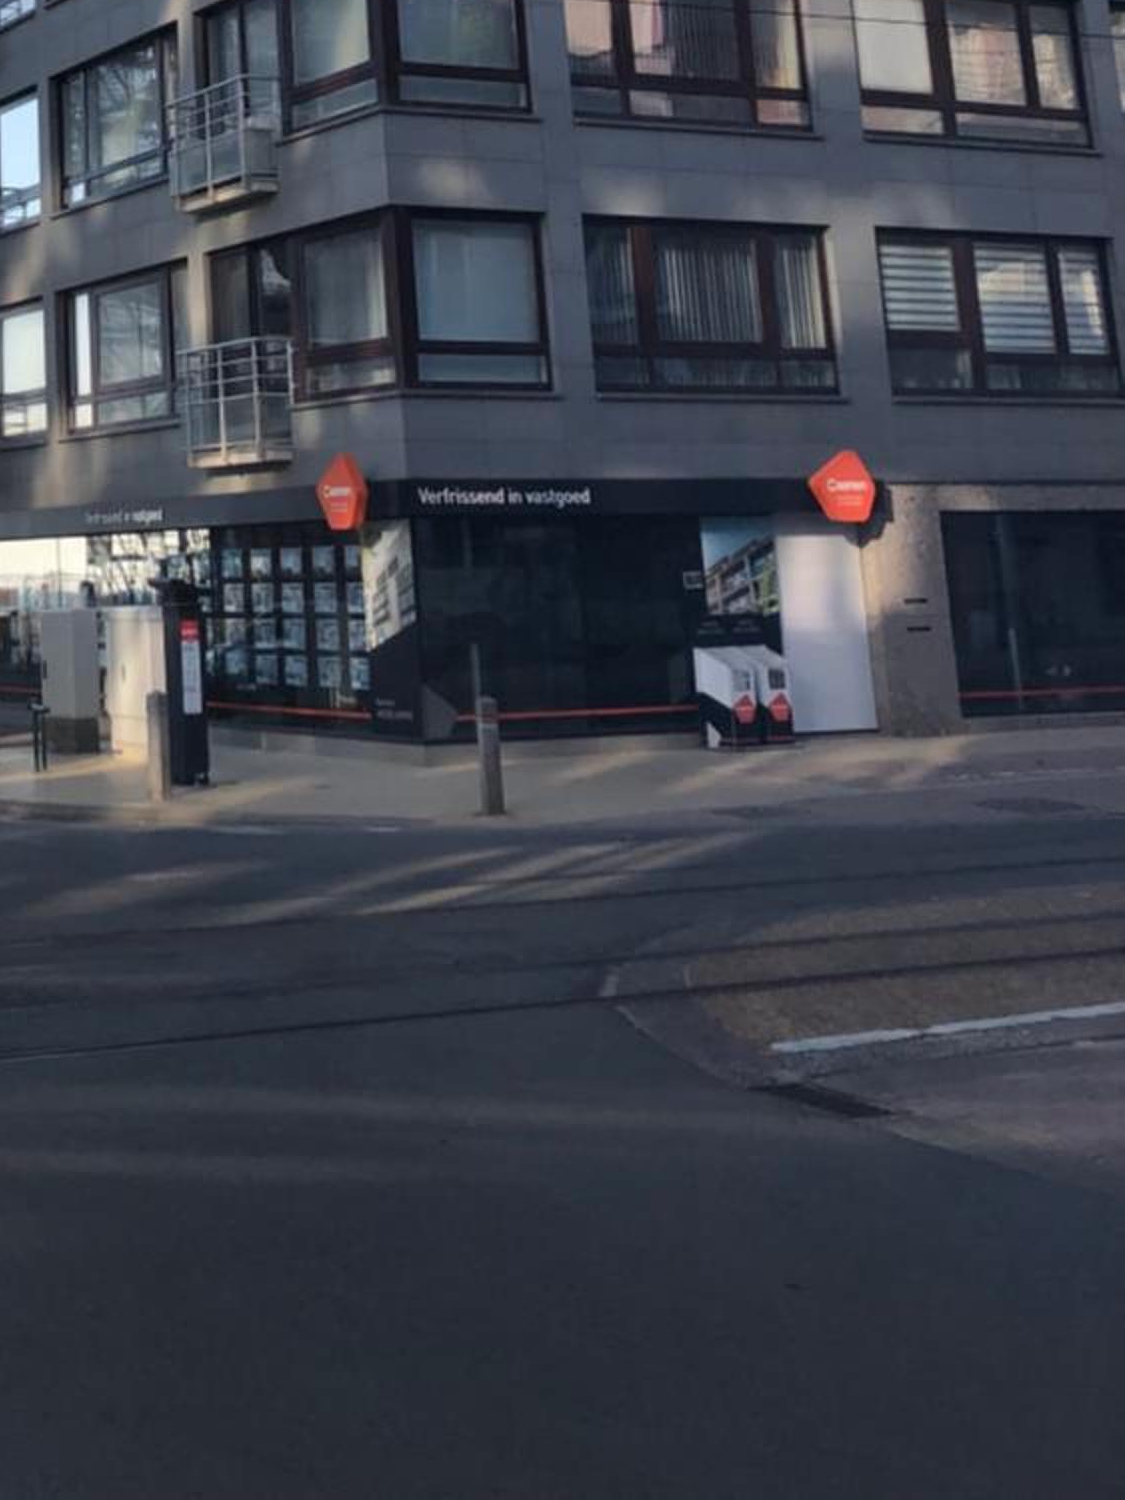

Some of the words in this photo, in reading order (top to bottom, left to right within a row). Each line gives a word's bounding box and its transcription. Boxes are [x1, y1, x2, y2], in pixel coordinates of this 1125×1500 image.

[418, 486, 505, 505] Verfrissend
[508, 487, 524, 505] in
[525, 487, 591, 509] vastgoed
